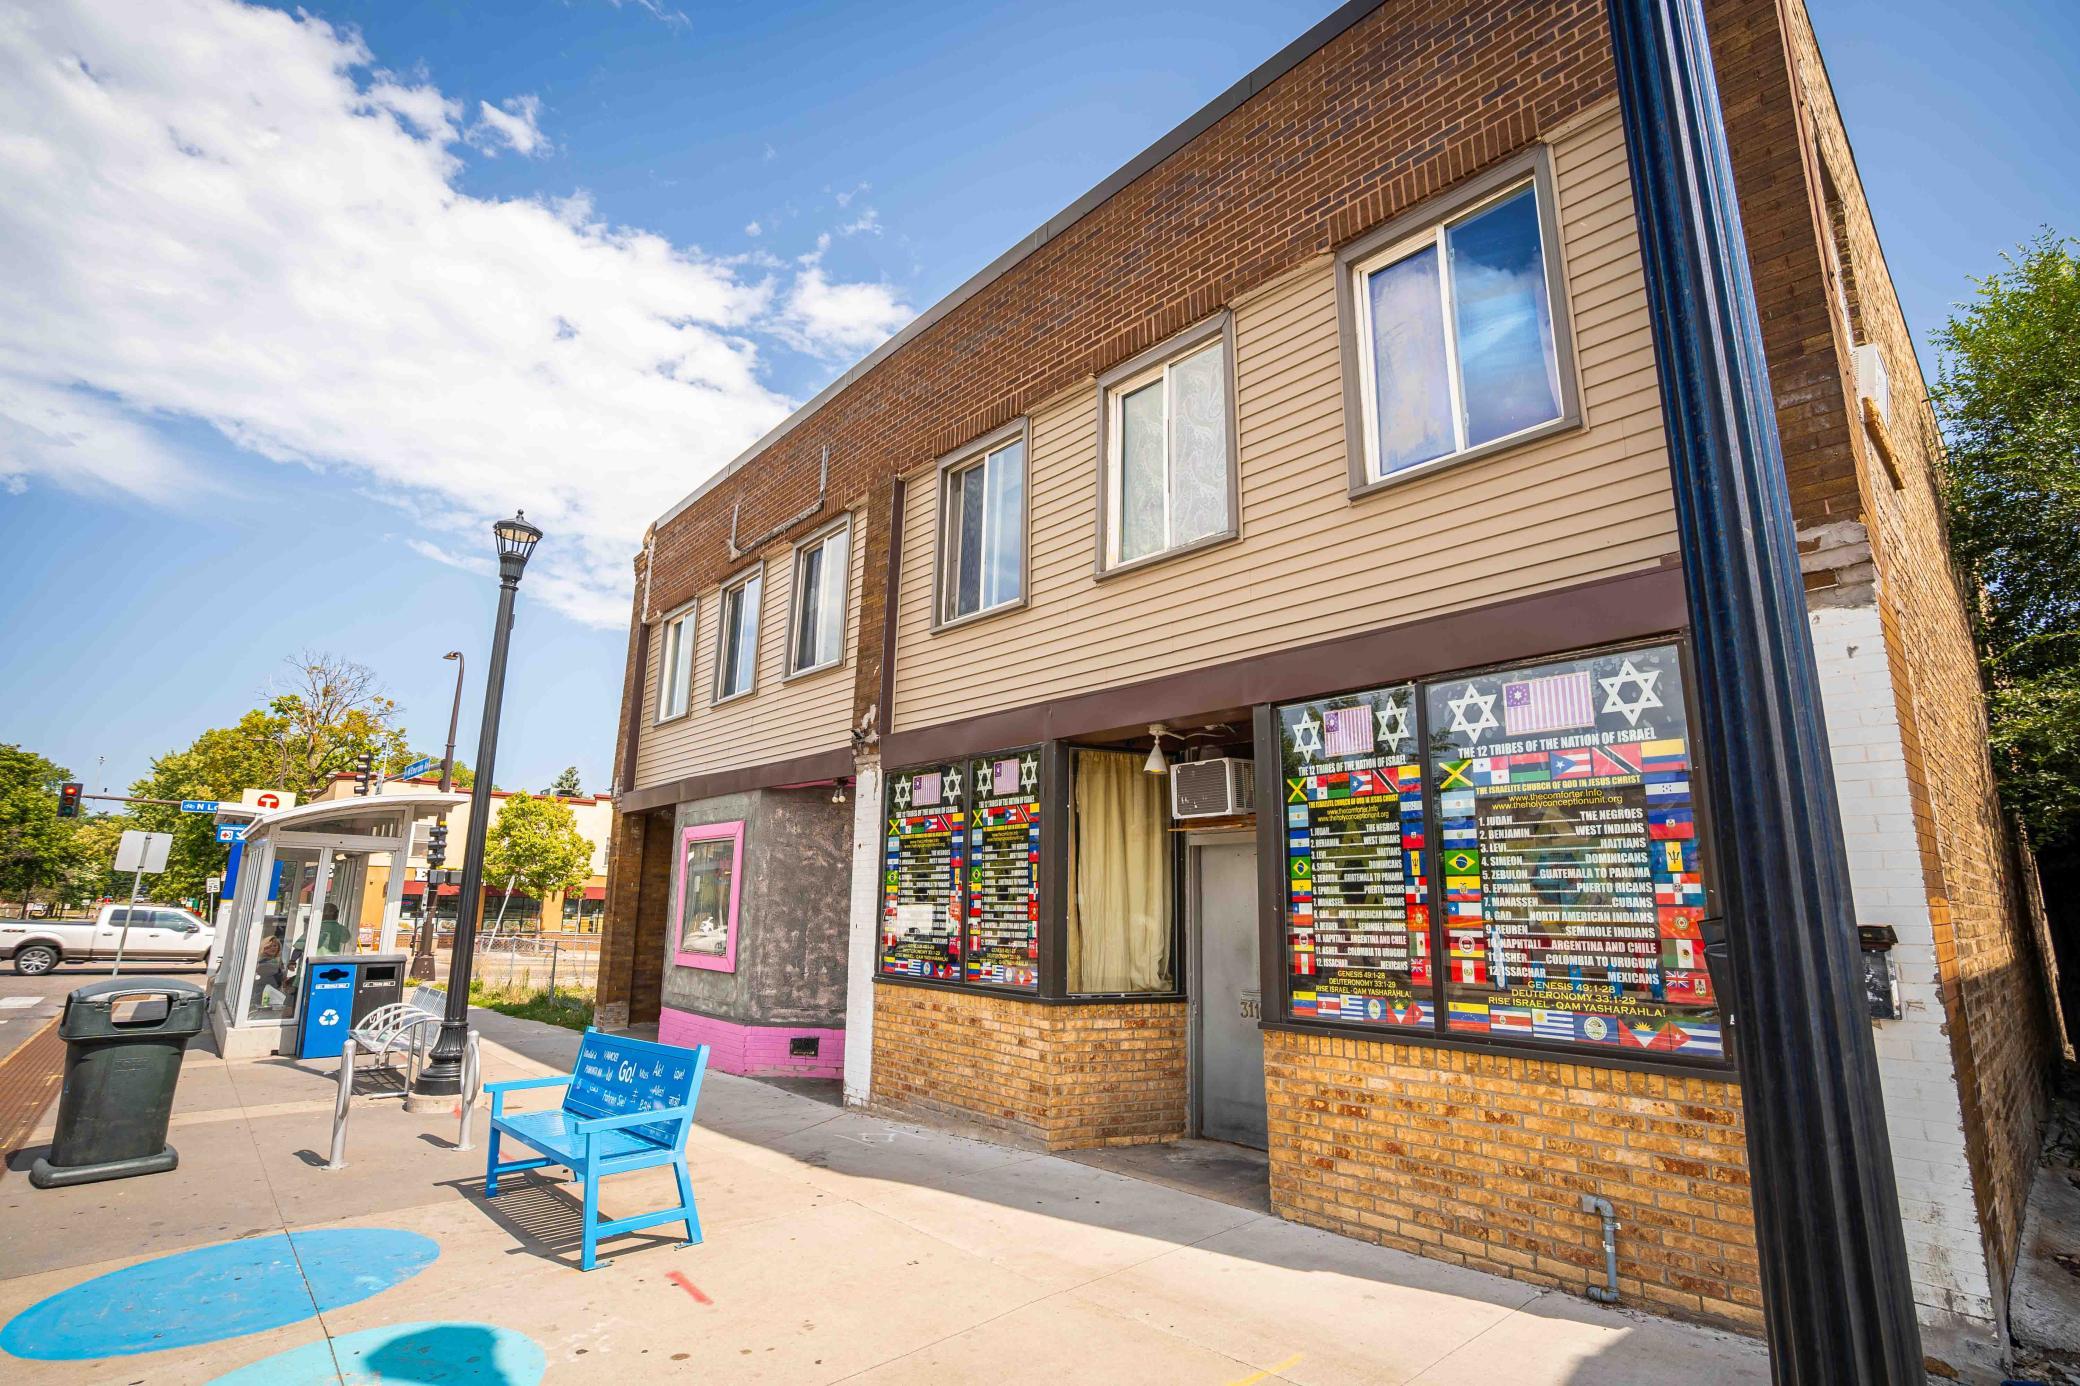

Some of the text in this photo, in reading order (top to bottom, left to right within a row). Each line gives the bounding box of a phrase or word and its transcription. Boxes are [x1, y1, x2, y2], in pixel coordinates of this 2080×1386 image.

[1458, 727, 1656, 759] THE 12 TRIBES OF THE NATION OF ISRAEL
[1298, 767, 1309, 776] THE
[1309, 766, 1315, 775] 12
[1316, 763, 1335, 774] TRIBES
[1336, 762, 1344, 772] OF
[1344, 760, 1355, 771] THE
[1377, 757, 1385, 767] OF
[1385, 754, 1407, 766] ISRAEL
[1476, 775, 1640, 795] THE ISRAELITE CHURCH OF GOD IN JESUS CHRIST
[1478, 808, 1643, 827] 1. JUDAH THE NEGROES
[1366, 823, 1376, 832] THE
[1376, 822, 1400, 832] NEGROES
[1480, 823, 1644, 840] 2. BENJAMIN WEST INDIANS
[1364, 836, 1377, 845] WEST
[1480, 837, 1646, 853] 3. LEVI HAITIANS
[1316, 850, 1326, 859] LEVI
[1481, 853, 1648, 866] 4. SIMEON DOMINICANS
[1374, 873, 1381, 881] TO
[1482, 867, 1651, 879] 5. ZEBULON GUATEMALA TO PANAMA
[208, 884, 219, 892] 25
[1364, 885, 1384, 894] PUERTO
[1385, 885, 1404, 894] RICANS
[1483, 882, 1652, 893] 6. EPHRAIM PUERTO RICANS
[1484, 897, 1653, 908] 7. MANASSEH CUBANS
[1485, 911, 1654, 923] 8. GAD NORTH AMERICAN INDIANS
[1495, 925, 1528, 935] REUBEN
[1565, 927, 1613, 938] SEMINOLE
[1614, 927, 1655, 939] INDIANS
[1351, 935, 1379, 944] ARGENTINA
[1379, 935, 1390, 944] AND
[1391, 935, 1406, 945] CHILE
[1374, 948, 1381, 957] TO
[1551, 941, 1603, 952] ARGENTINA
[1605, 942, 1625, 953] AND
[1627, 942, 1657, 954] CHILE
[1380, 960, 1408, 970] MEXICANS
[1500, 952, 1527, 963] ASHER
[1546, 954, 1594, 966] COLOMBIA
[1596, 955, 1608, 966] TO
[1610, 957, 1658, 969] URUGUAY
[1337, 970, 1363, 978] GENESIS
[1608, 972, 1659, 985] MEXICANS
[1329, 977, 1396, 988] DEUTERONOMY 33:1-29
[1528, 980, 1615, 994] GENESIS 49:1-28
[1330, 986, 1350, 994] ISRAEL
[1353, 987, 1367, 995] QAM
[1512, 988, 1636, 1005] DEUTERONOMY 33:1-29
[1488, 996, 1666, 1017] RISE ISRAEL QAM YASHARAHLA!
[618, 1060, 637, 1083] Go!
